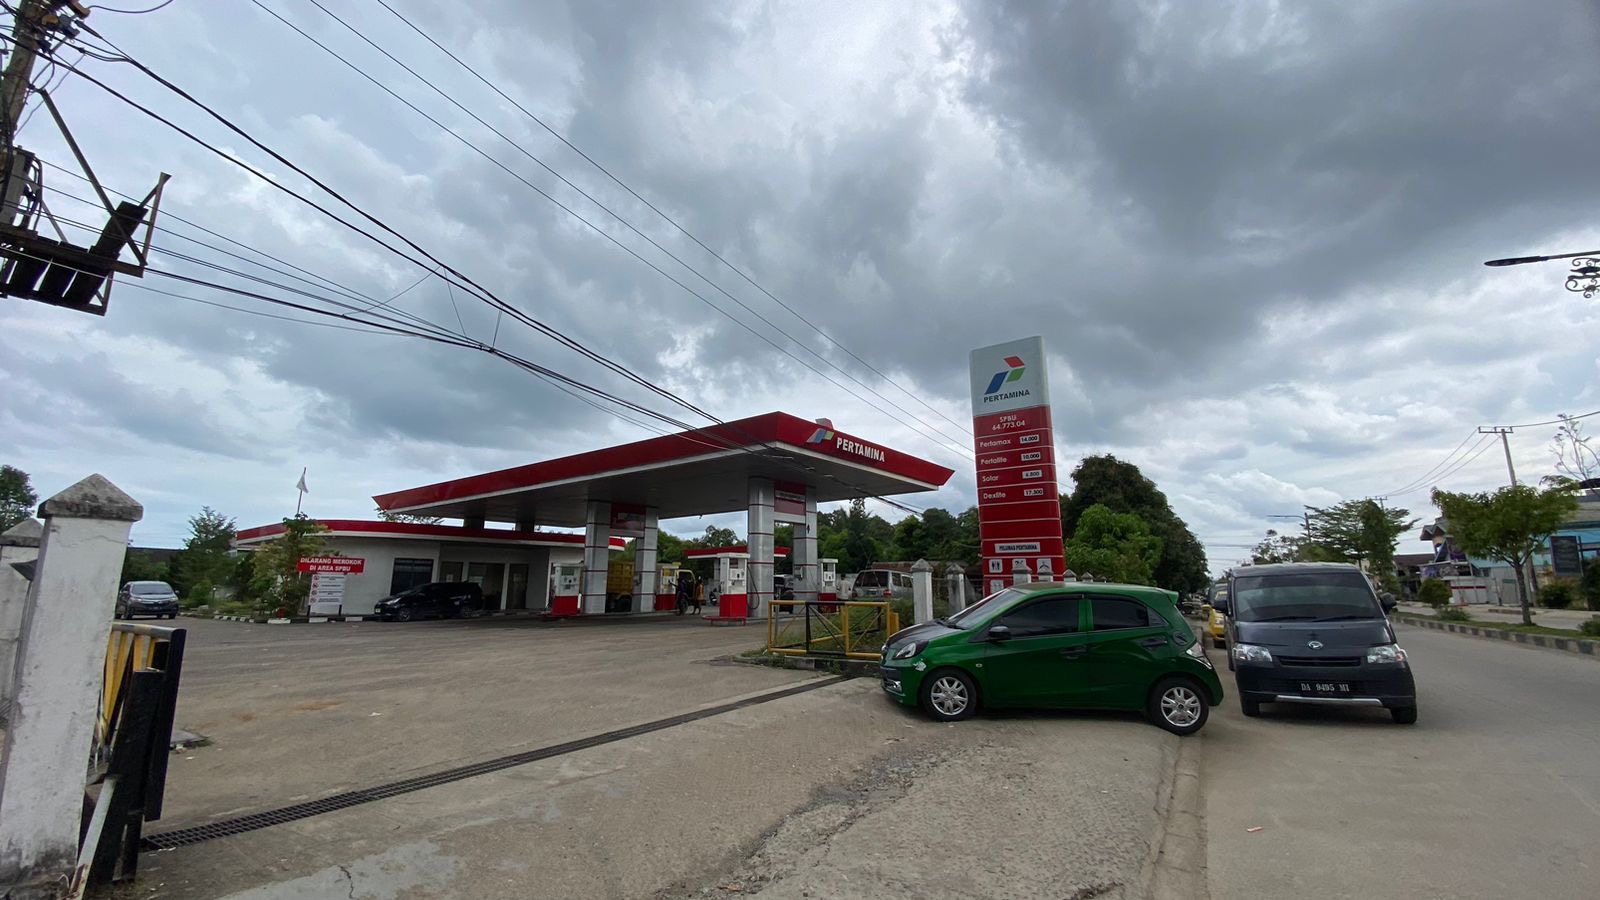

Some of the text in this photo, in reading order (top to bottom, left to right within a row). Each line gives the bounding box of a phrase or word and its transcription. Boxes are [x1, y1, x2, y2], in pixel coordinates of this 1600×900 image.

[983, 389, 1030, 403] PERTAMINA
[1000, 415, 1017, 423] SPBU
[980, 439, 1011, 448] Pertamax
[836, 437, 885, 462] PERTAMINA
[980, 456, 1008, 465] Pertalite
[300, 557, 362, 566] DILARANG MEROKOK
